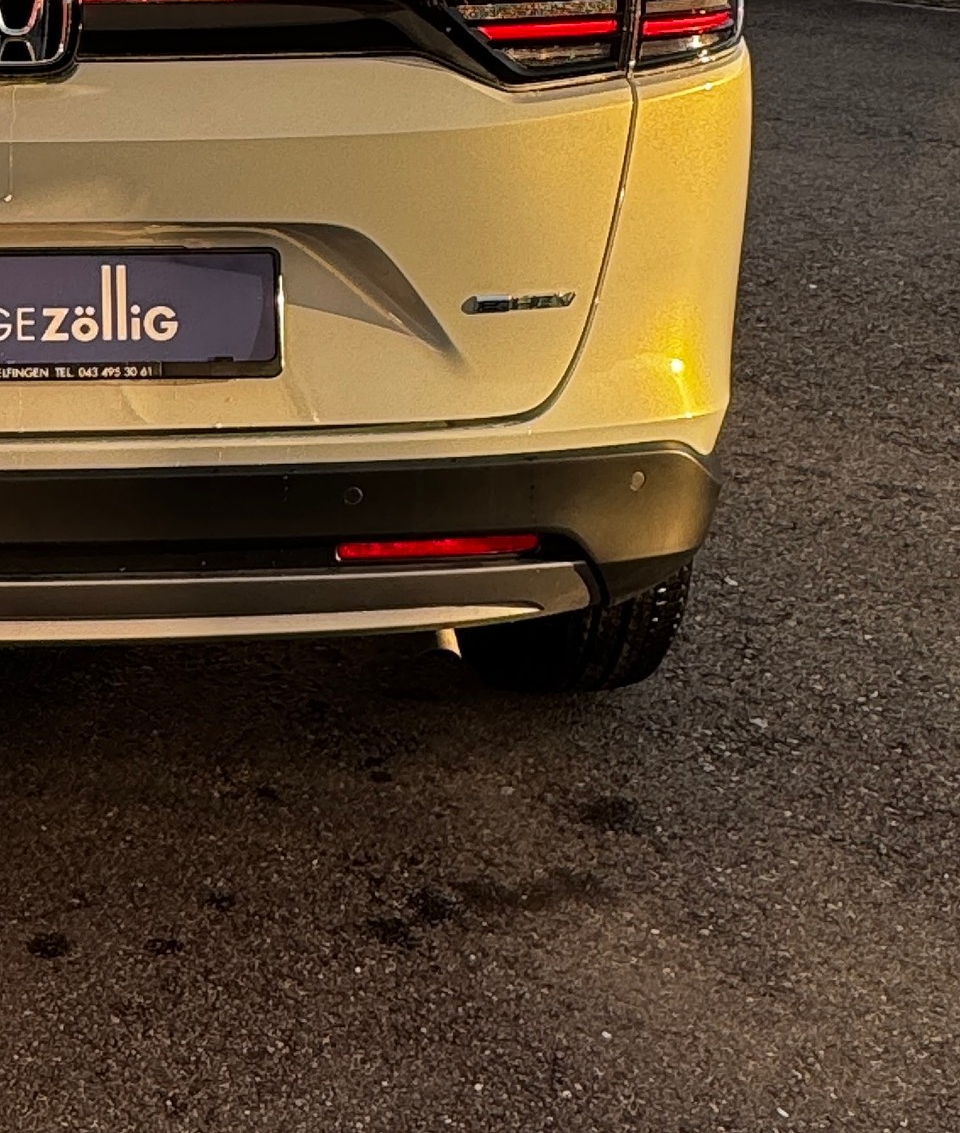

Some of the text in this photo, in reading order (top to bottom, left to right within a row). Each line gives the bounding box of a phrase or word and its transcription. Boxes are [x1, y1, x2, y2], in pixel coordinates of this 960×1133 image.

[78, 366, 98, 378] 043
[124, 366, 138, 377] 30
[140, 366, 153, 377] 61
